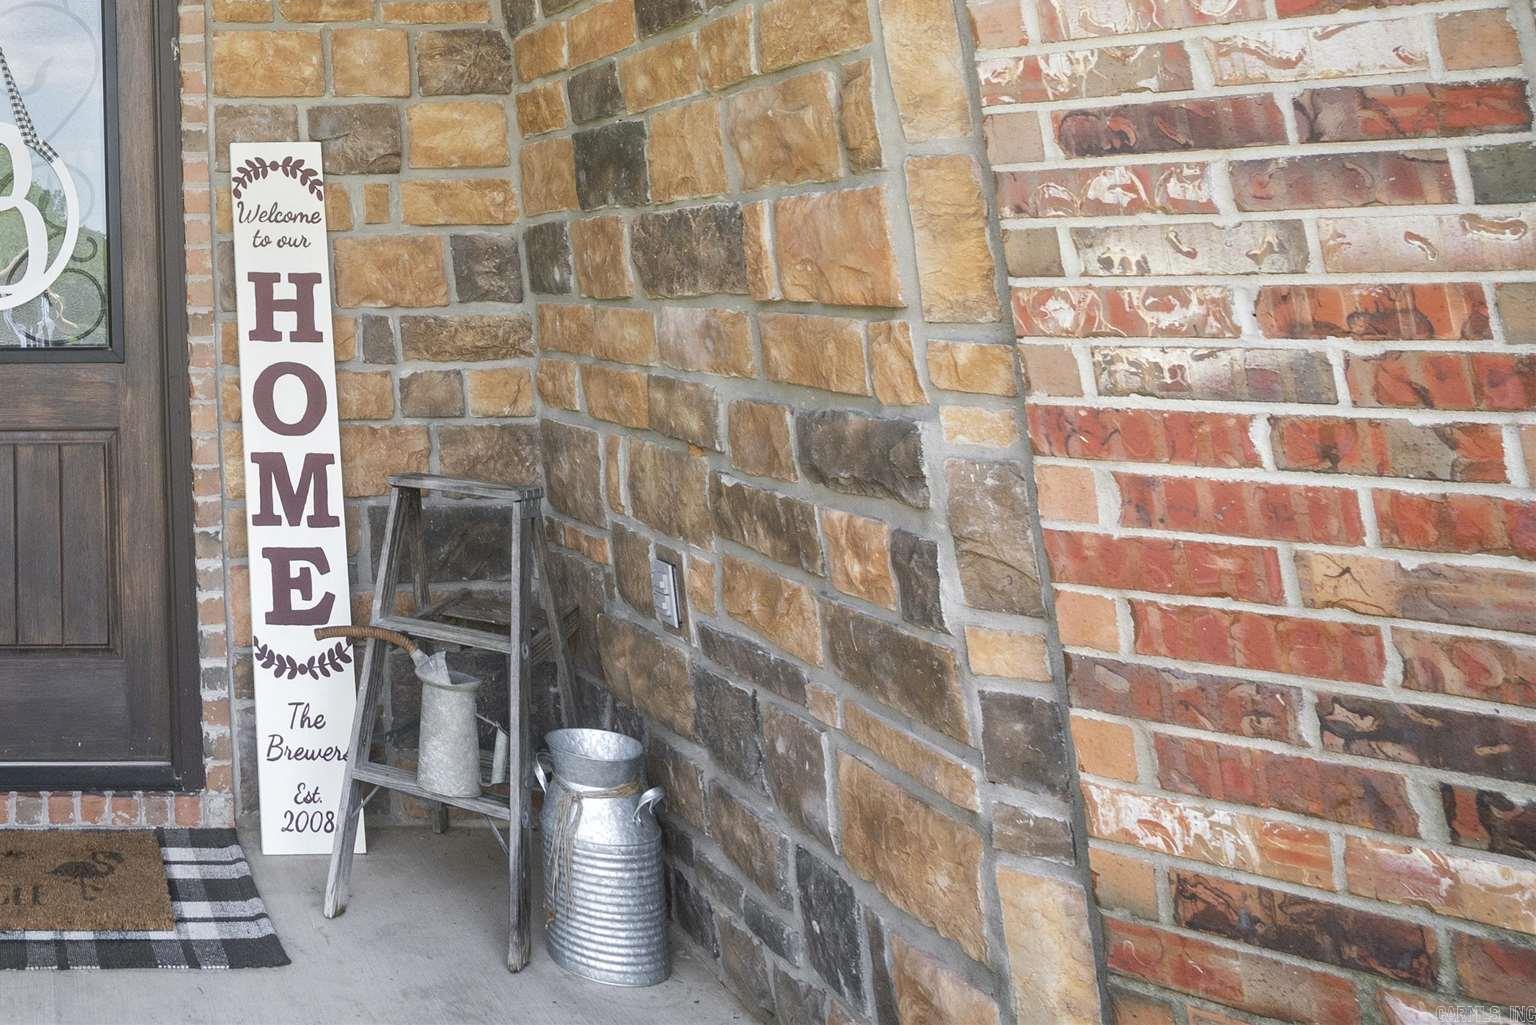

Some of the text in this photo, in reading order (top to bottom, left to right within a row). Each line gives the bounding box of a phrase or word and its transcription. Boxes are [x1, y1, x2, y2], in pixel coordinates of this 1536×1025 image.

[237, 200, 322, 224] Welcome
[252, 229, 312, 248] to our
[247, 271, 340, 626] HOME
[287, 701, 327, 730] The
[293, 782, 323, 805] Est.
[280, 809, 336, 833] 2008
